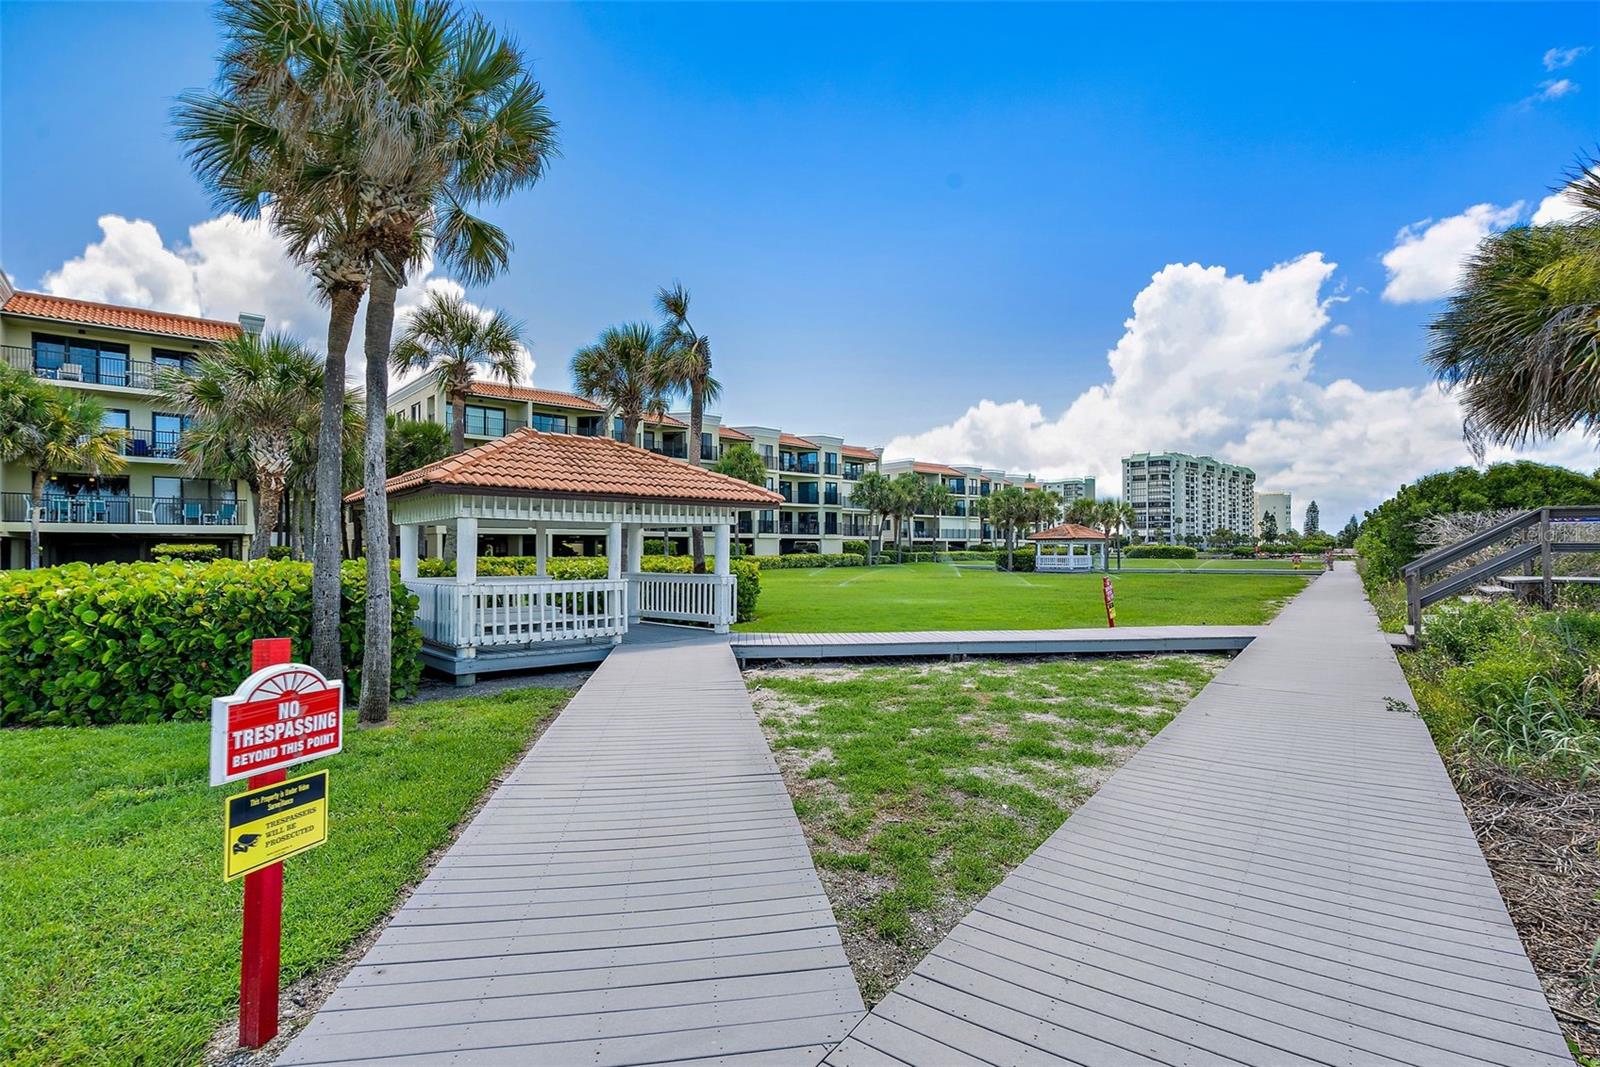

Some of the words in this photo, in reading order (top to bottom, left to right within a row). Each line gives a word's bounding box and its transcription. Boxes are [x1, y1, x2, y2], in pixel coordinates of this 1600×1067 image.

[278, 700, 300, 720] NO
[232, 711, 337, 750] TRESPASSING
[232, 746, 278, 768] BEYOND
[281, 740, 305, 756] THIS
[307, 732, 336, 749] POINT
[250, 798, 260, 807] This
[260, 792, 279, 804] Property
[265, 806, 317, 829] TRESPASSERS
[265, 826, 285, 838] WILL
[286, 822, 297, 832] BE
[265, 825, 315, 848] PROSECUTED
